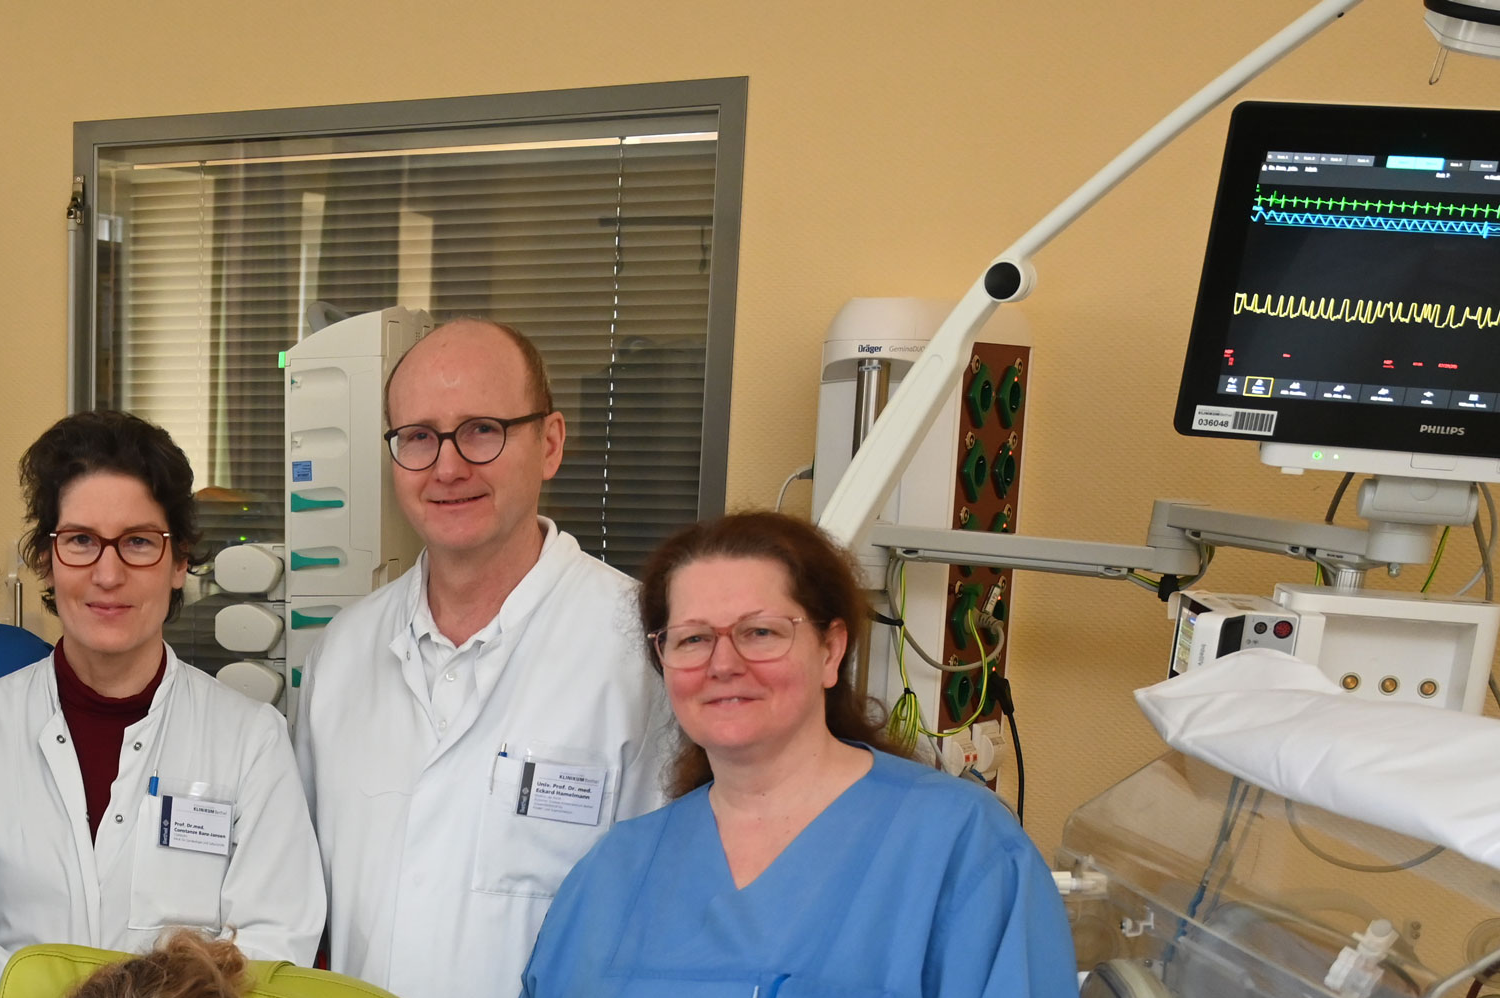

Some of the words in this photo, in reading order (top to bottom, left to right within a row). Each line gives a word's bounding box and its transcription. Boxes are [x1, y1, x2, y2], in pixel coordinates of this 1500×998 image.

[858, 344, 883, 354] Dräger
[1198, 418, 1230, 428] 036048
[1419, 424, 1466, 436] PHILIPS
[536, 788, 555, 796] Eckard
